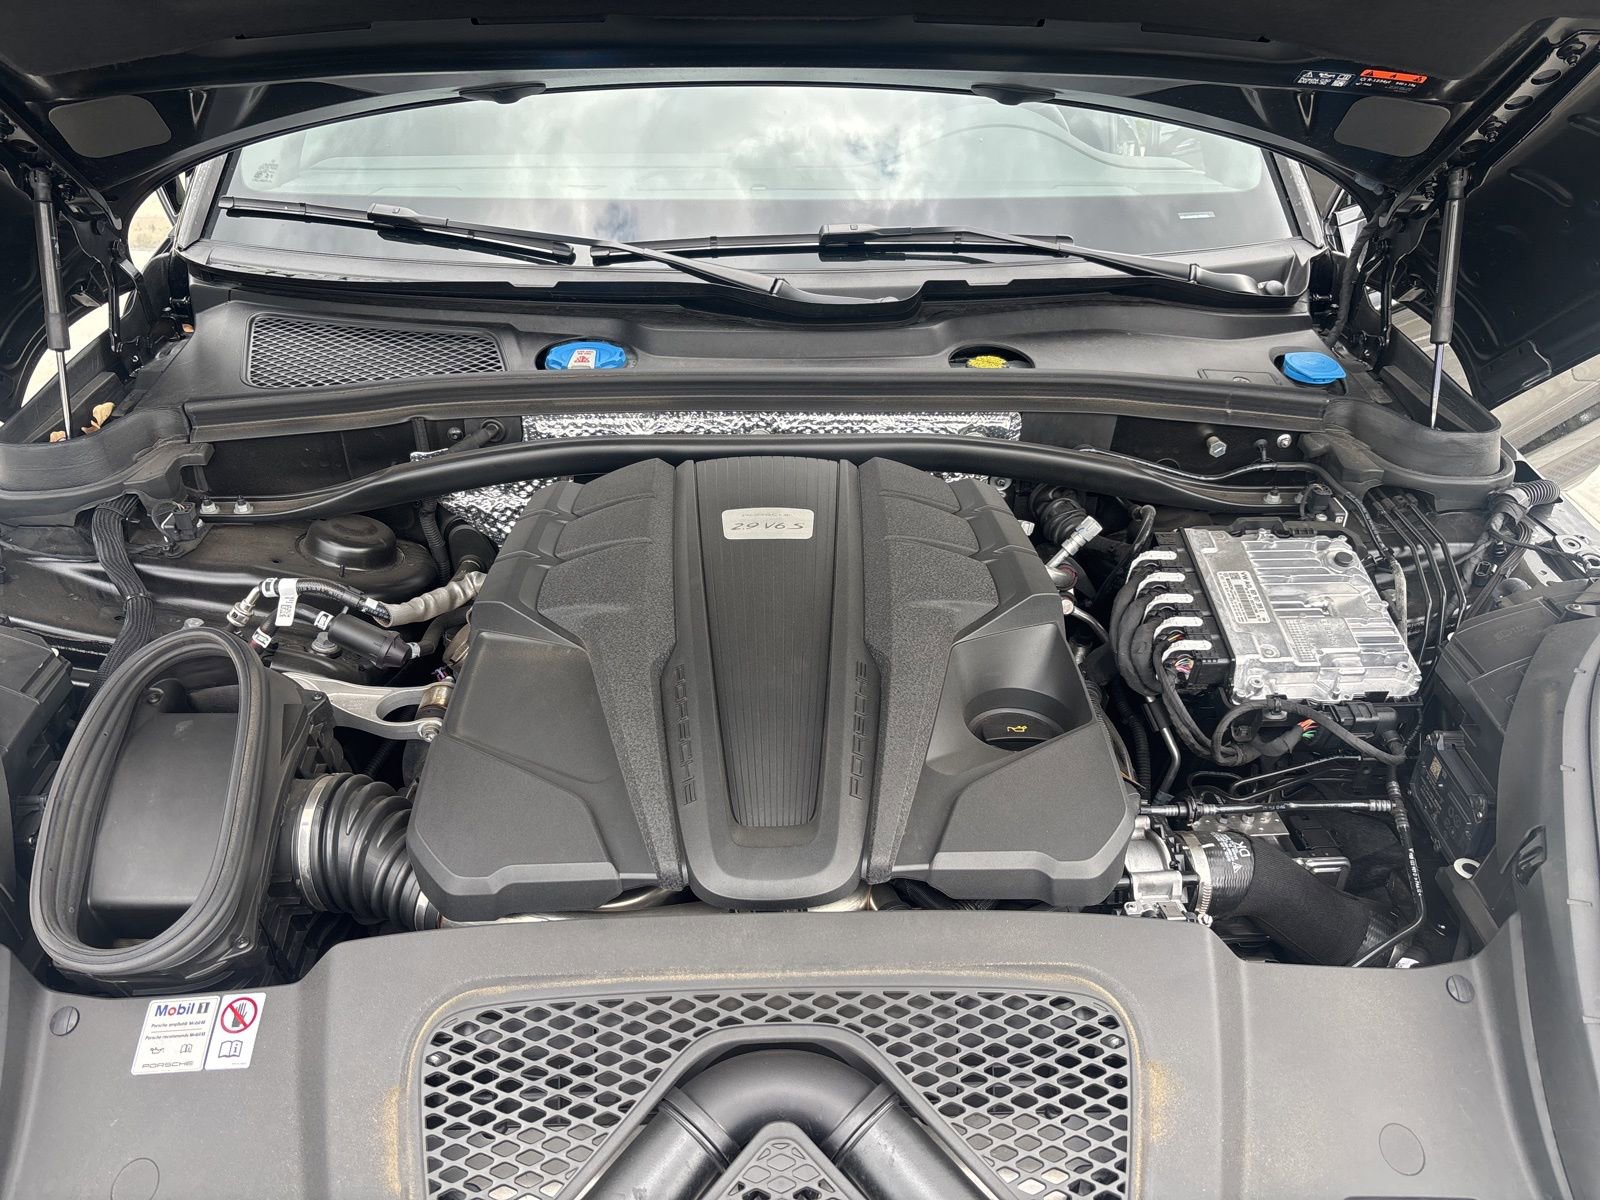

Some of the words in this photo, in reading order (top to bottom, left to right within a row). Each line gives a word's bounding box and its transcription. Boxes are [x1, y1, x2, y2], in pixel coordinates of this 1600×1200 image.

[730, 522, 760, 531] 2.9
[764, 522, 786, 530] V6
[786, 522, 805, 530] S
[673, 663, 697, 806] PORSCHE
[849, 660, 868, 801] PORSCHE
[154, 1002, 195, 1017] Mobil
[141, 1060, 194, 1069] PORSCHE
